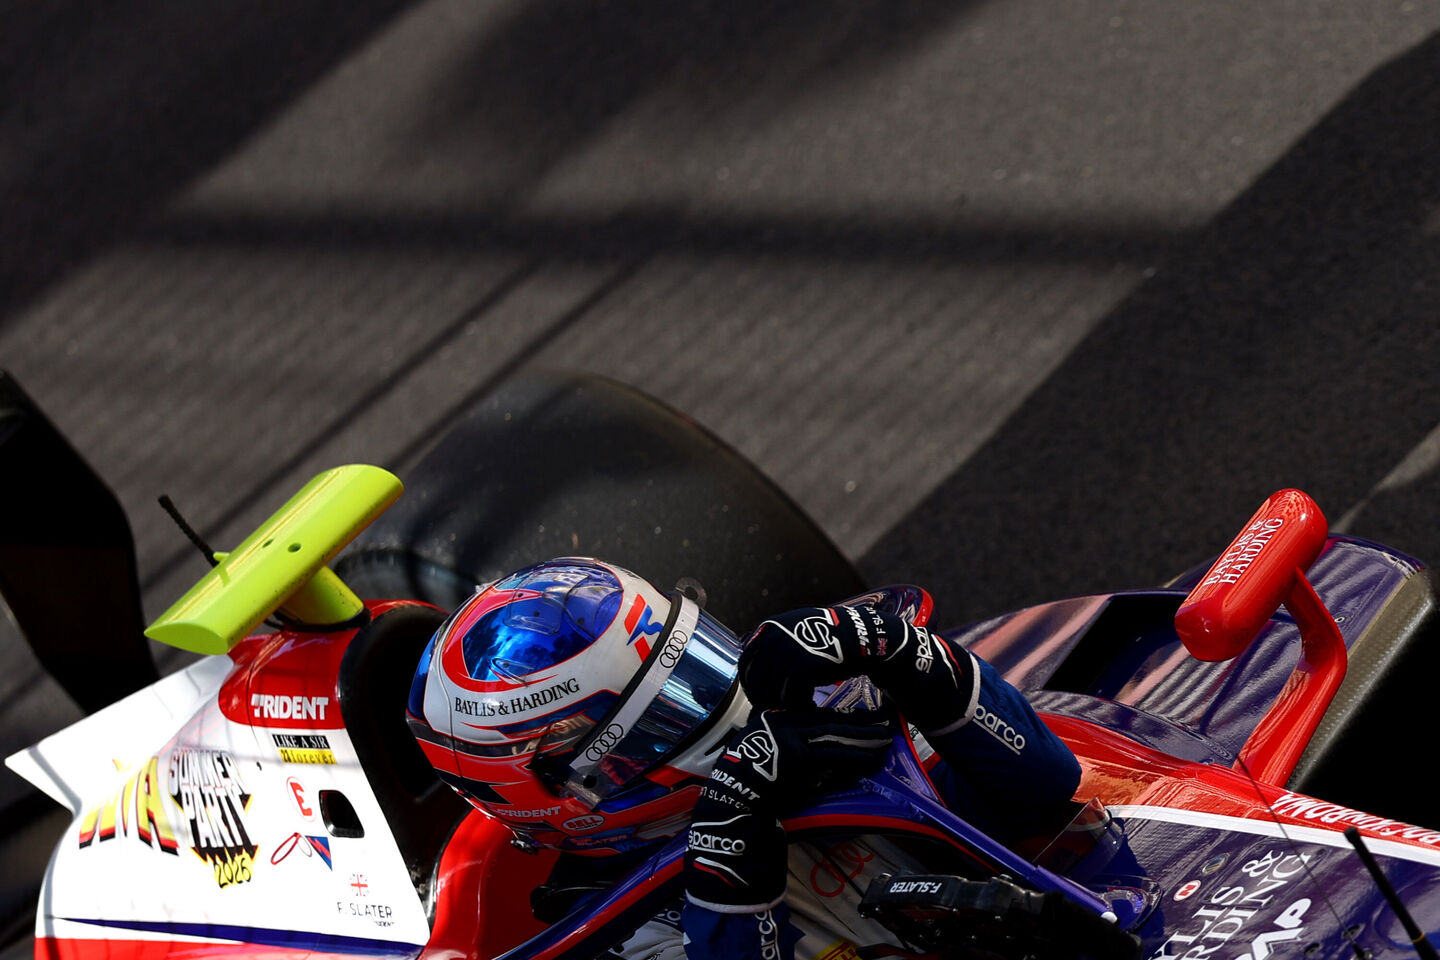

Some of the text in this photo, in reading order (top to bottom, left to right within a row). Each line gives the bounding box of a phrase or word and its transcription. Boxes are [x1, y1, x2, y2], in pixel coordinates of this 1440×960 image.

[1203, 532, 1255, 586] BAYLIS
[1219, 518, 1283, 584] HARDING
[251, 694, 339, 720] TRIDENT
[455, 678, 580, 718] BAYLIS & HARDING
[274, 735, 328, 748] LIKE A SIR
[974, 705, 1026, 755] parco
[711, 768, 760, 801] RIDENT
[688, 830, 746, 856] sparco
[214, 856, 252, 889] 2026
[1241, 850, 1283, 878] &
[889, 881, 942, 894] F.SLATER
[350, 903, 393, 919] SLATER
